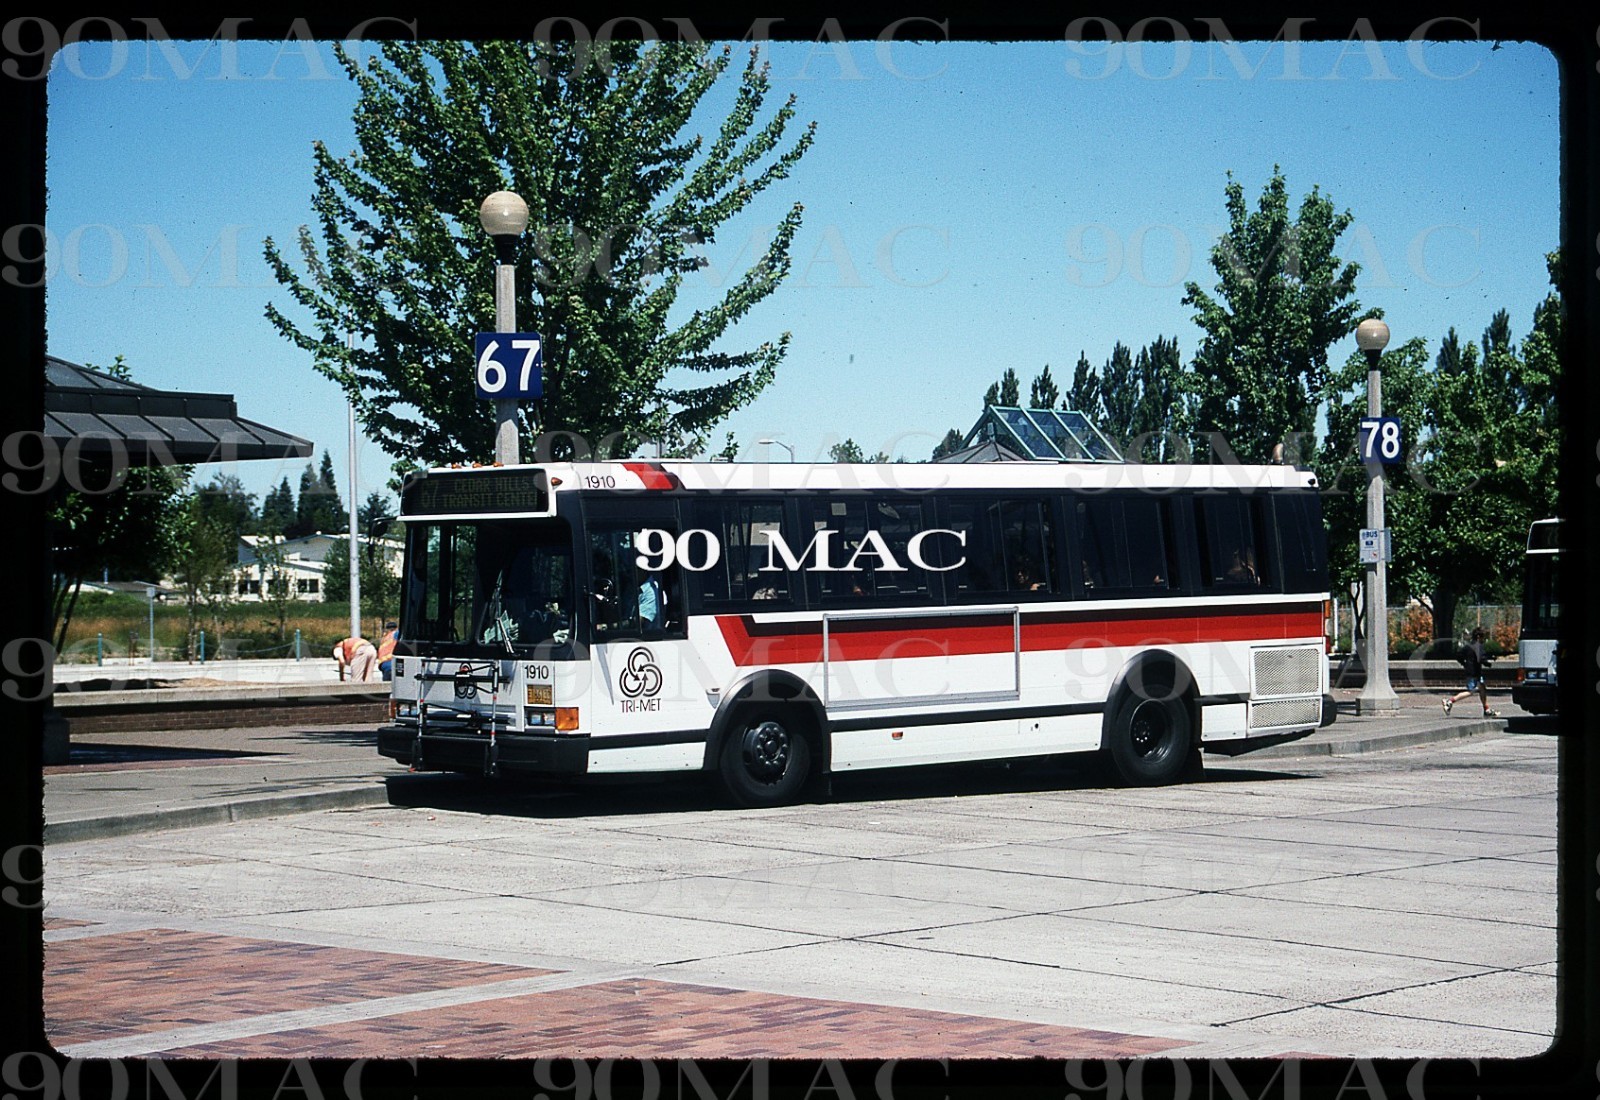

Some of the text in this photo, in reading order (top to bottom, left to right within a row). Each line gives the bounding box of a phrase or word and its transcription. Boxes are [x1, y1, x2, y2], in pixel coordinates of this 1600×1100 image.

[478, 340, 540, 393] 67
[1361, 421, 1399, 459] 78
[495, 477, 530, 491] HILLS
[585, 475, 615, 489] 1910
[443, 493, 493, 508] TRANSIT
[1366, 530, 1378, 538] BUS
[524, 665, 549, 679] 1910
[620, 698, 661, 713] TRI-MET
